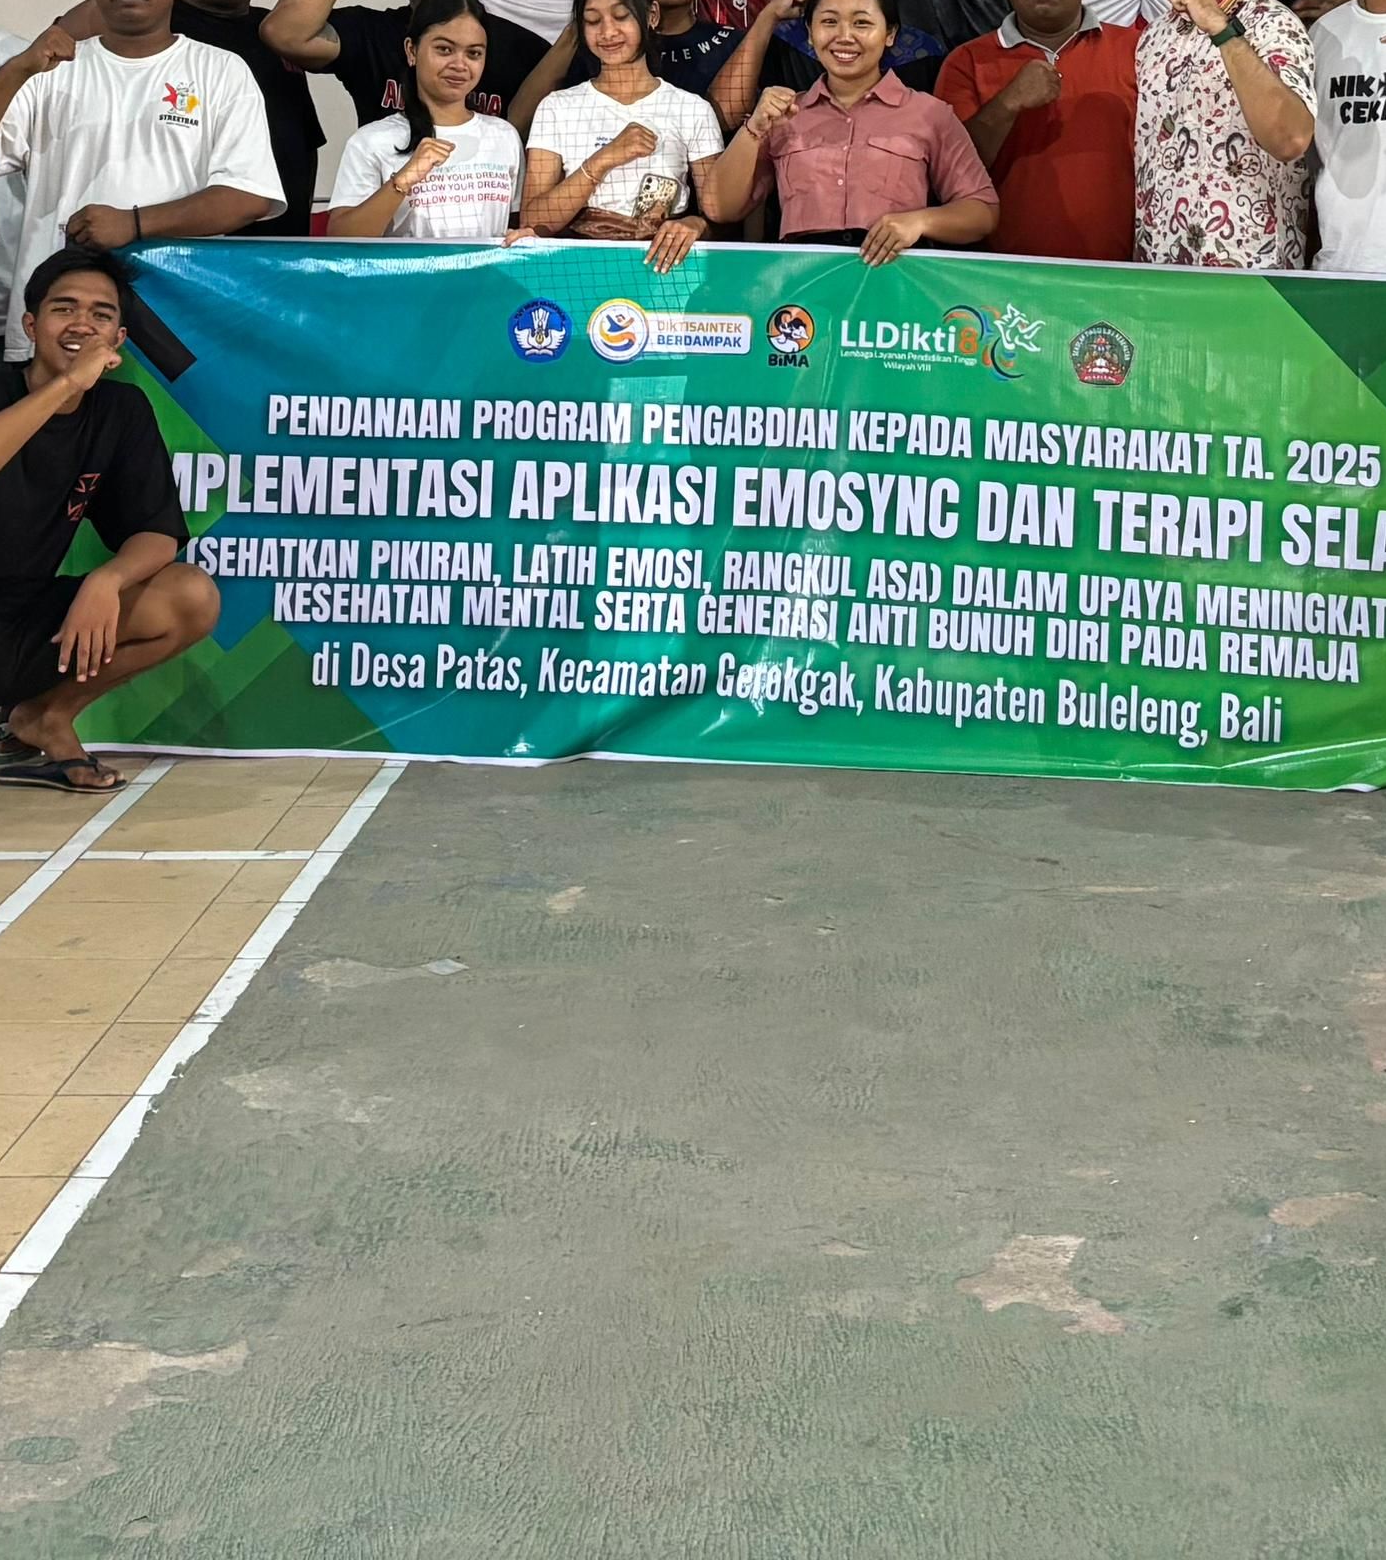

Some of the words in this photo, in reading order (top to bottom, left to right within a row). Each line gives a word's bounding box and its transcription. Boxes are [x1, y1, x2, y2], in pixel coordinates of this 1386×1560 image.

[447, 172, 473, 181] YOUR
[409, 183, 447, 195] OLLOW
[448, 181, 474, 191] YOUR
[477, 180, 510, 191] DREAMS
[409, 195, 447, 207] FOLLOW
[449, 194, 475, 203] YOUR
[477, 193, 509, 203] DREAMS
[657, 320, 742, 333] DIKTISAINTEK
[657, 334, 742, 348] BERDAMPAK
[840, 349, 873, 359] Lembaga
[874, 350, 906, 361] Layanan
[907, 352, 952, 364] Pendidikan
[883, 361, 916, 372] Wilayah
[917, 363, 931, 372] VIII
[269, 395, 460, 438] PENDANAAN
[473, 401, 631, 444] PROGRAM
[644, 405, 837, 448] PENGABDIAN
[849, 412, 971, 457] KEPADA
[986, 421, 1212, 474] MASYARAKAT
[1224, 437, 1272, 479] TA.
[1289, 441, 1380, 487] 2025
[172, 452, 494, 518] MPLEMENTASI
[510, 462, 716, 524] APLIKASI
[734, 469, 959, 538] EMOSYNC
[978, 483, 1074, 547] DAN
[1094, 491, 1263, 562] TERAPI
[371, 541, 501, 587] PIKIRAN,
[514, 546, 596, 584] LATIH
[608, 546, 712, 594] EMOSI,
[725, 552, 855, 597] RANGKUL
[869, 560, 941, 603] ASA)
[954, 566, 1067, 613] DALAM
[1081, 577, 1183, 622] UPAYA
[274, 583, 450, 624] KESEHATAN
[463, 587, 582, 629] MENTAL
[595, 592, 685, 632] SERTA
[697, 594, 837, 643] GENERASI
[849, 604, 917, 646] ANTI
[929, 609, 1034, 655] BUNUH
[1048, 618, 1109, 661] DIRI
[1122, 625, 1206, 669] PADA
[1221, 632, 1358, 682] REMAJA
[313, 643, 339, 685] di
[351, 643, 425, 687] Desa
[437, 645, 527, 698] Patas,
[539, 651, 706, 696] Kecamatan
[717, 652, 863, 716] Gerokgak,
[877, 668, 1044, 726] Kabupaten
[1058, 681, 1207, 747] Buleleng,
[1221, 694, 1281, 741] Bali
